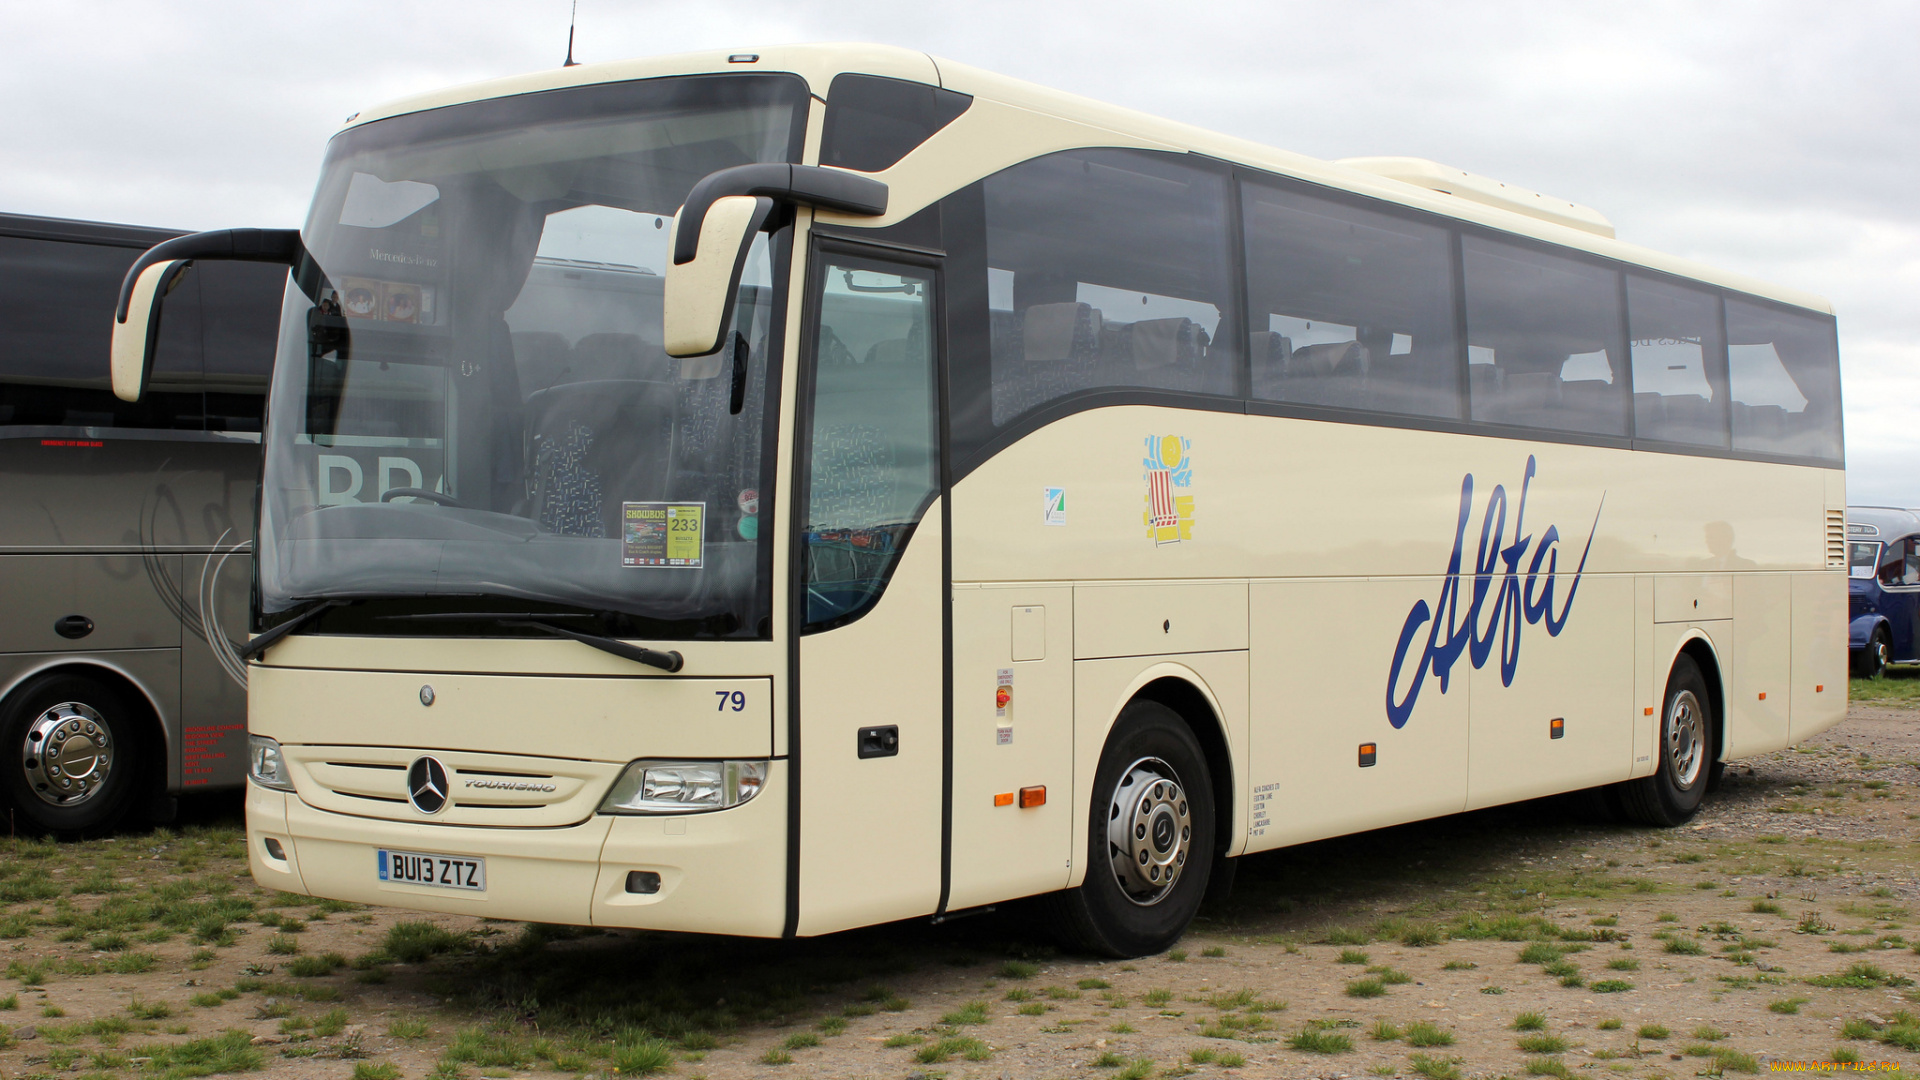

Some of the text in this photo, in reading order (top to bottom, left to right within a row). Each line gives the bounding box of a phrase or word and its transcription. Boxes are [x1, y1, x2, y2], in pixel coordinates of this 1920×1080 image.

[369, 248, 438, 266] Mercedes-Bnz
[671, 518, 698, 531] 233
[1386, 454, 1606, 729] Alfa
[715, 691, 746, 712] 79
[464, 779, 557, 793] TOURISMO
[393, 855, 478, 887] BU13 ZTZ
